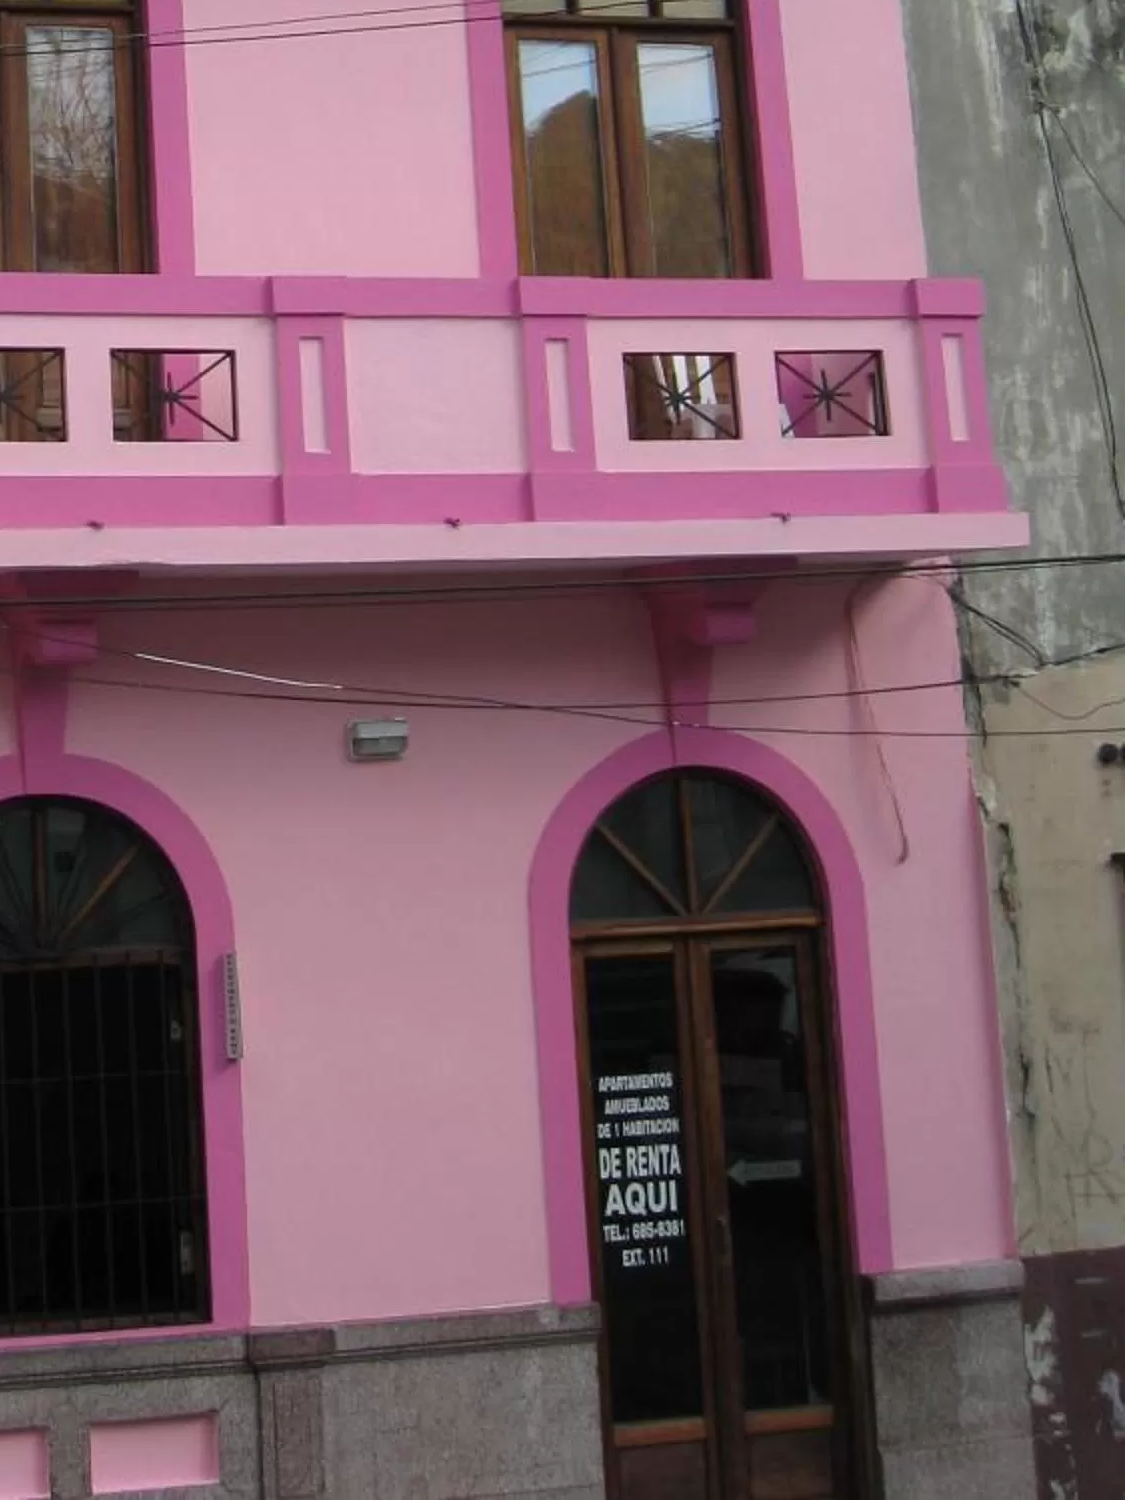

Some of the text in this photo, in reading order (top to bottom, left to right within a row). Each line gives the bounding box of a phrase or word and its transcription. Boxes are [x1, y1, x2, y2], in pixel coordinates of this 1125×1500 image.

[598, 1072, 673, 1092] APARTAMENTOS
[604, 1095, 670, 1115] AMUEBLADOS
[597, 1123, 611, 1138] DE
[599, 1144, 682, 1179] DE RENTA
[605, 1180, 678, 1217] AQUI
[622, 1245, 669, 1267] EXT. 111
